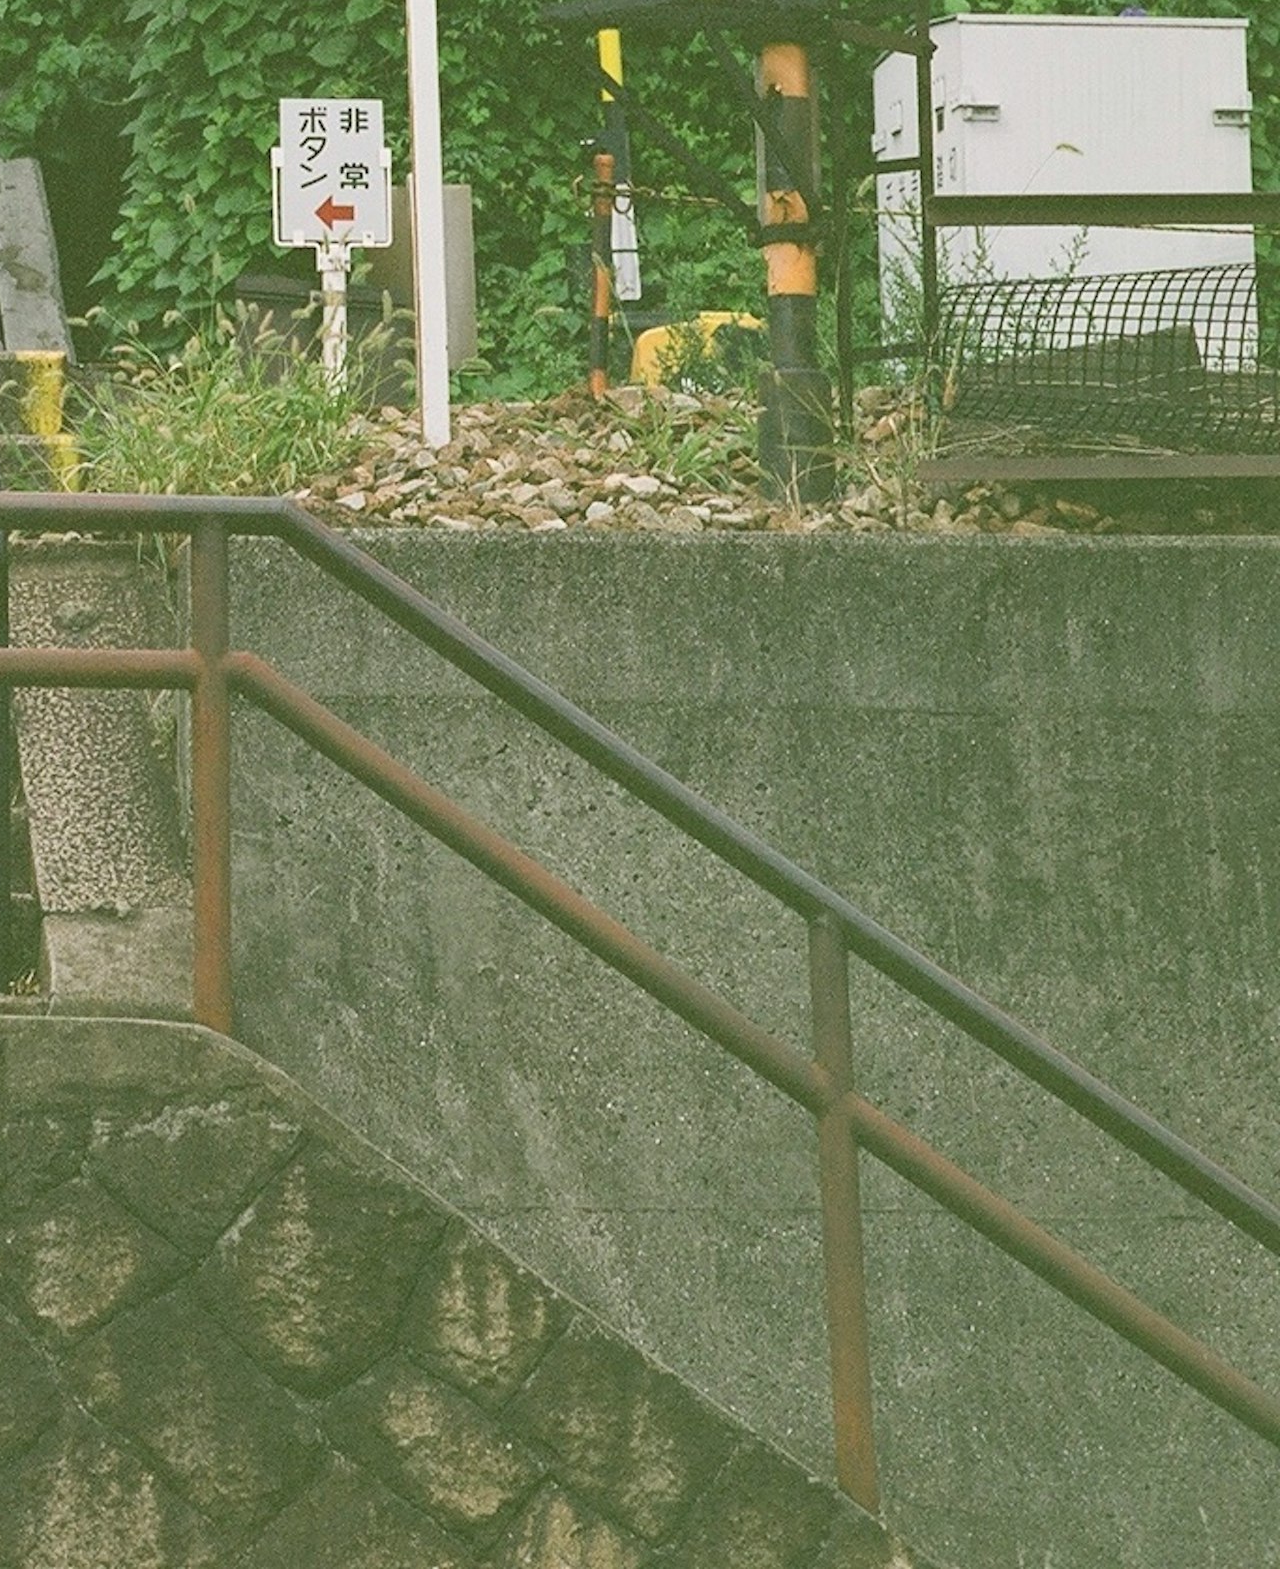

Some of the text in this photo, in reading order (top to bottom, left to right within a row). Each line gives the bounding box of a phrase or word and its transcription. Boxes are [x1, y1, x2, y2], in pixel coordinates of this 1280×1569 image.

[298, 107, 329, 189] ボタン
[340, 108, 369, 190] 非常
